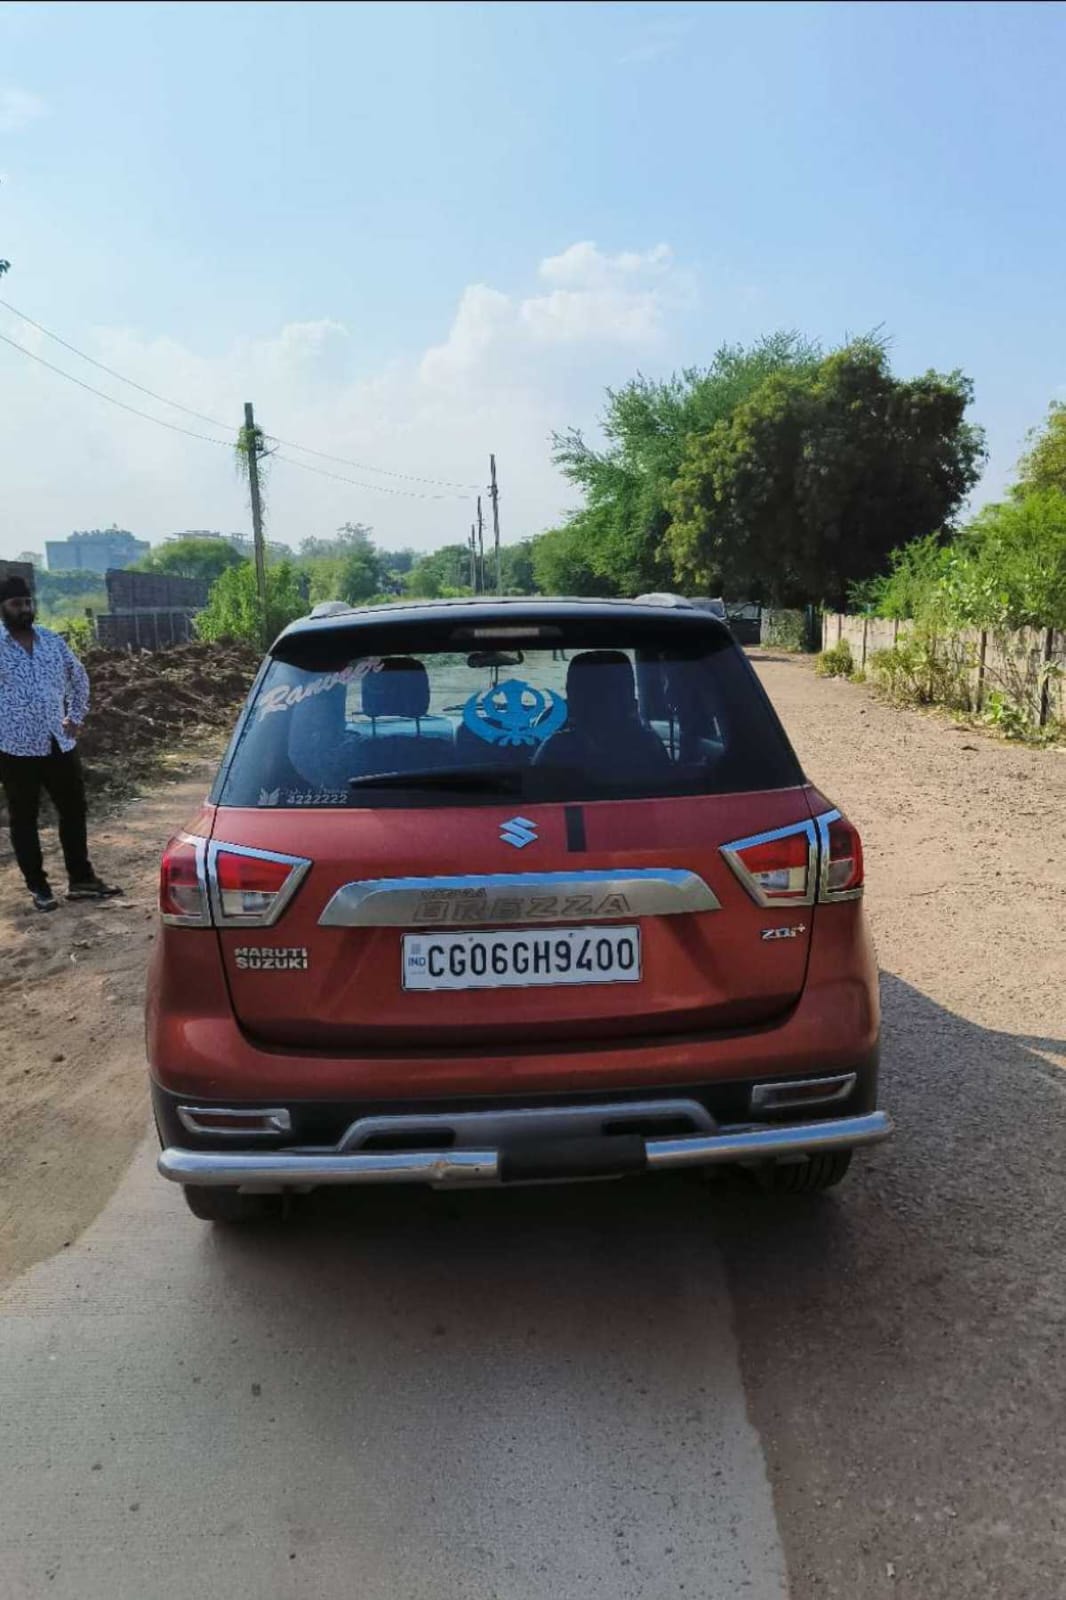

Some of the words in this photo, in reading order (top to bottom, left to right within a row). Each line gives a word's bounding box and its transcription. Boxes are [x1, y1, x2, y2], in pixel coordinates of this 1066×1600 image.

[413, 893, 632, 922] BREZZA
[234, 947, 308, 958] MARUTI
[407, 956, 426, 967] IND
[428, 938, 635, 977] CG06GH9400
[235, 957, 308, 969] SUZUKI
